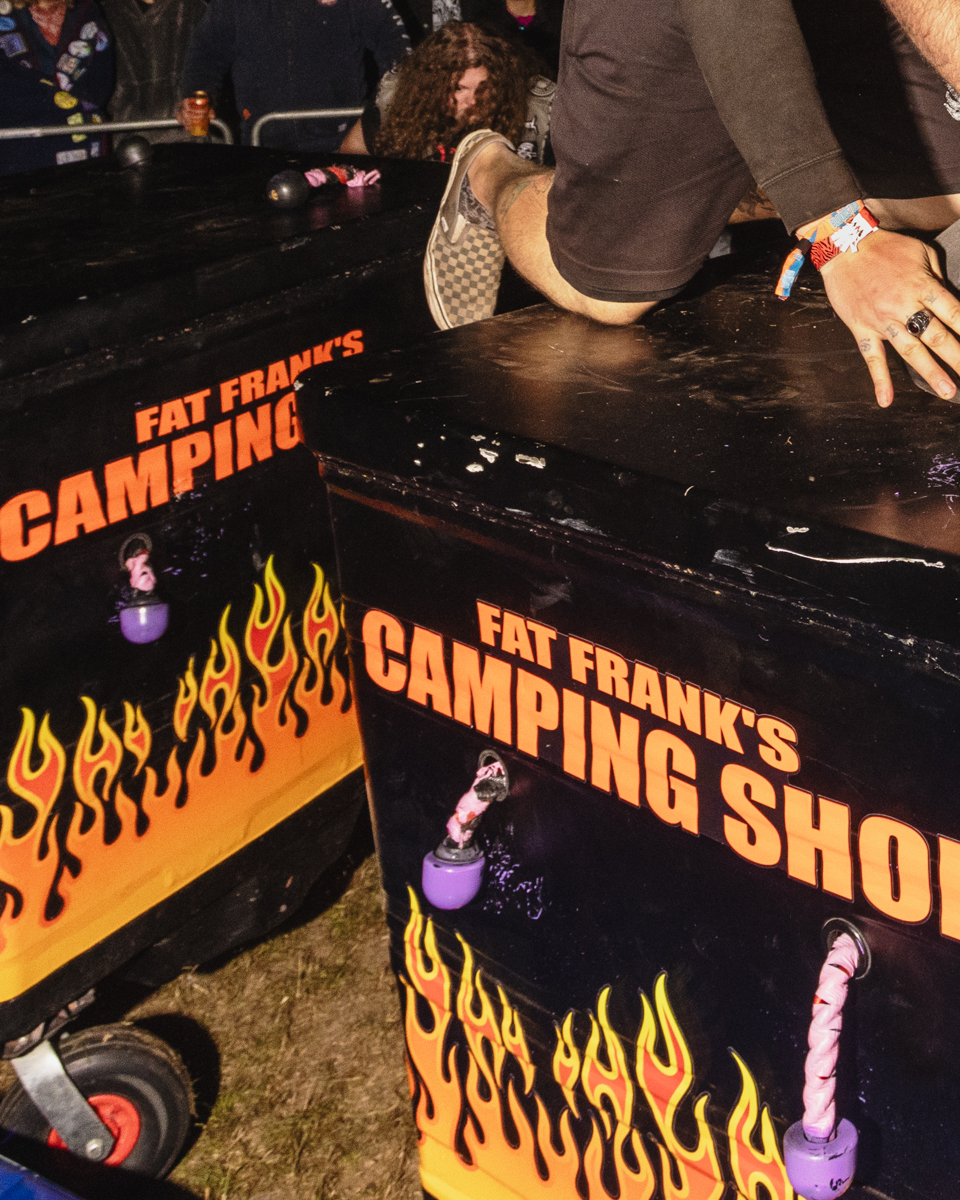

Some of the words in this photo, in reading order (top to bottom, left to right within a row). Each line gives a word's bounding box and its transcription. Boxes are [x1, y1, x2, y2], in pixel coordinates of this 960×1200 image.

[136, 388, 212, 444] FAT
[219, 329, 364, 414] FRANK'S
[0, 392, 304, 562] CAMPING
[361, 609, 700, 835] CAMPING
[476, 601, 558, 670] FAT
[568, 636, 800, 773] FRANK'S
